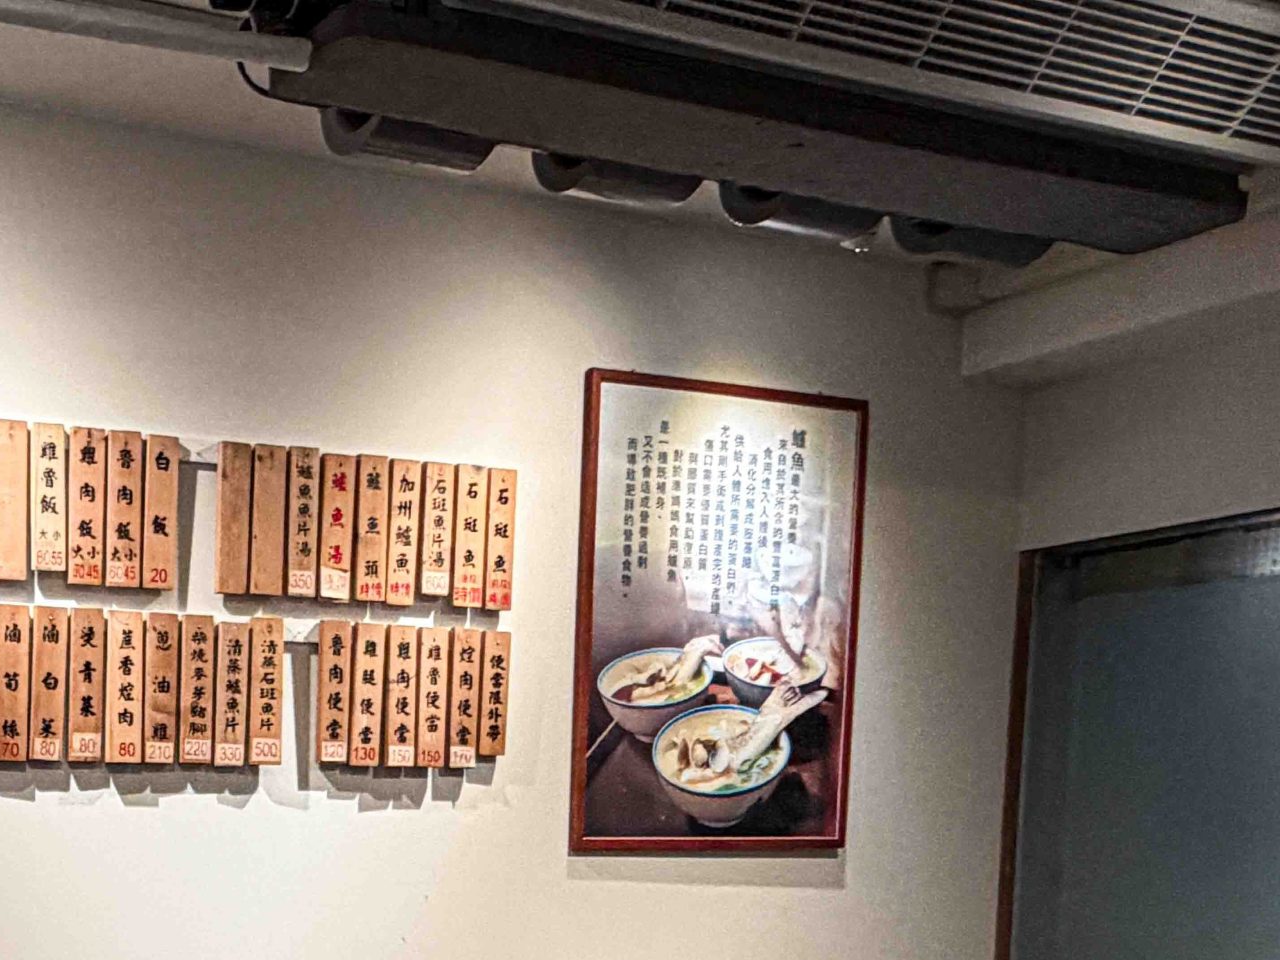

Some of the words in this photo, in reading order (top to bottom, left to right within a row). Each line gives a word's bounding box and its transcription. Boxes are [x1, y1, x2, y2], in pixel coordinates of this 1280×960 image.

[151, 568, 168, 583] 20
[2, 743, 19, 758] 70
[39, 741, 57, 756] 80
[79, 738, 96, 754] 80
[118, 742, 135, 757] 80
[148, 745, 171, 760] 210
[186, 741, 208, 757] 220
[254, 743, 278, 758] 500
[219, 747, 242, 762] 330
[352, 747, 376, 762] 130
[421, 750, 441, 763] 150
